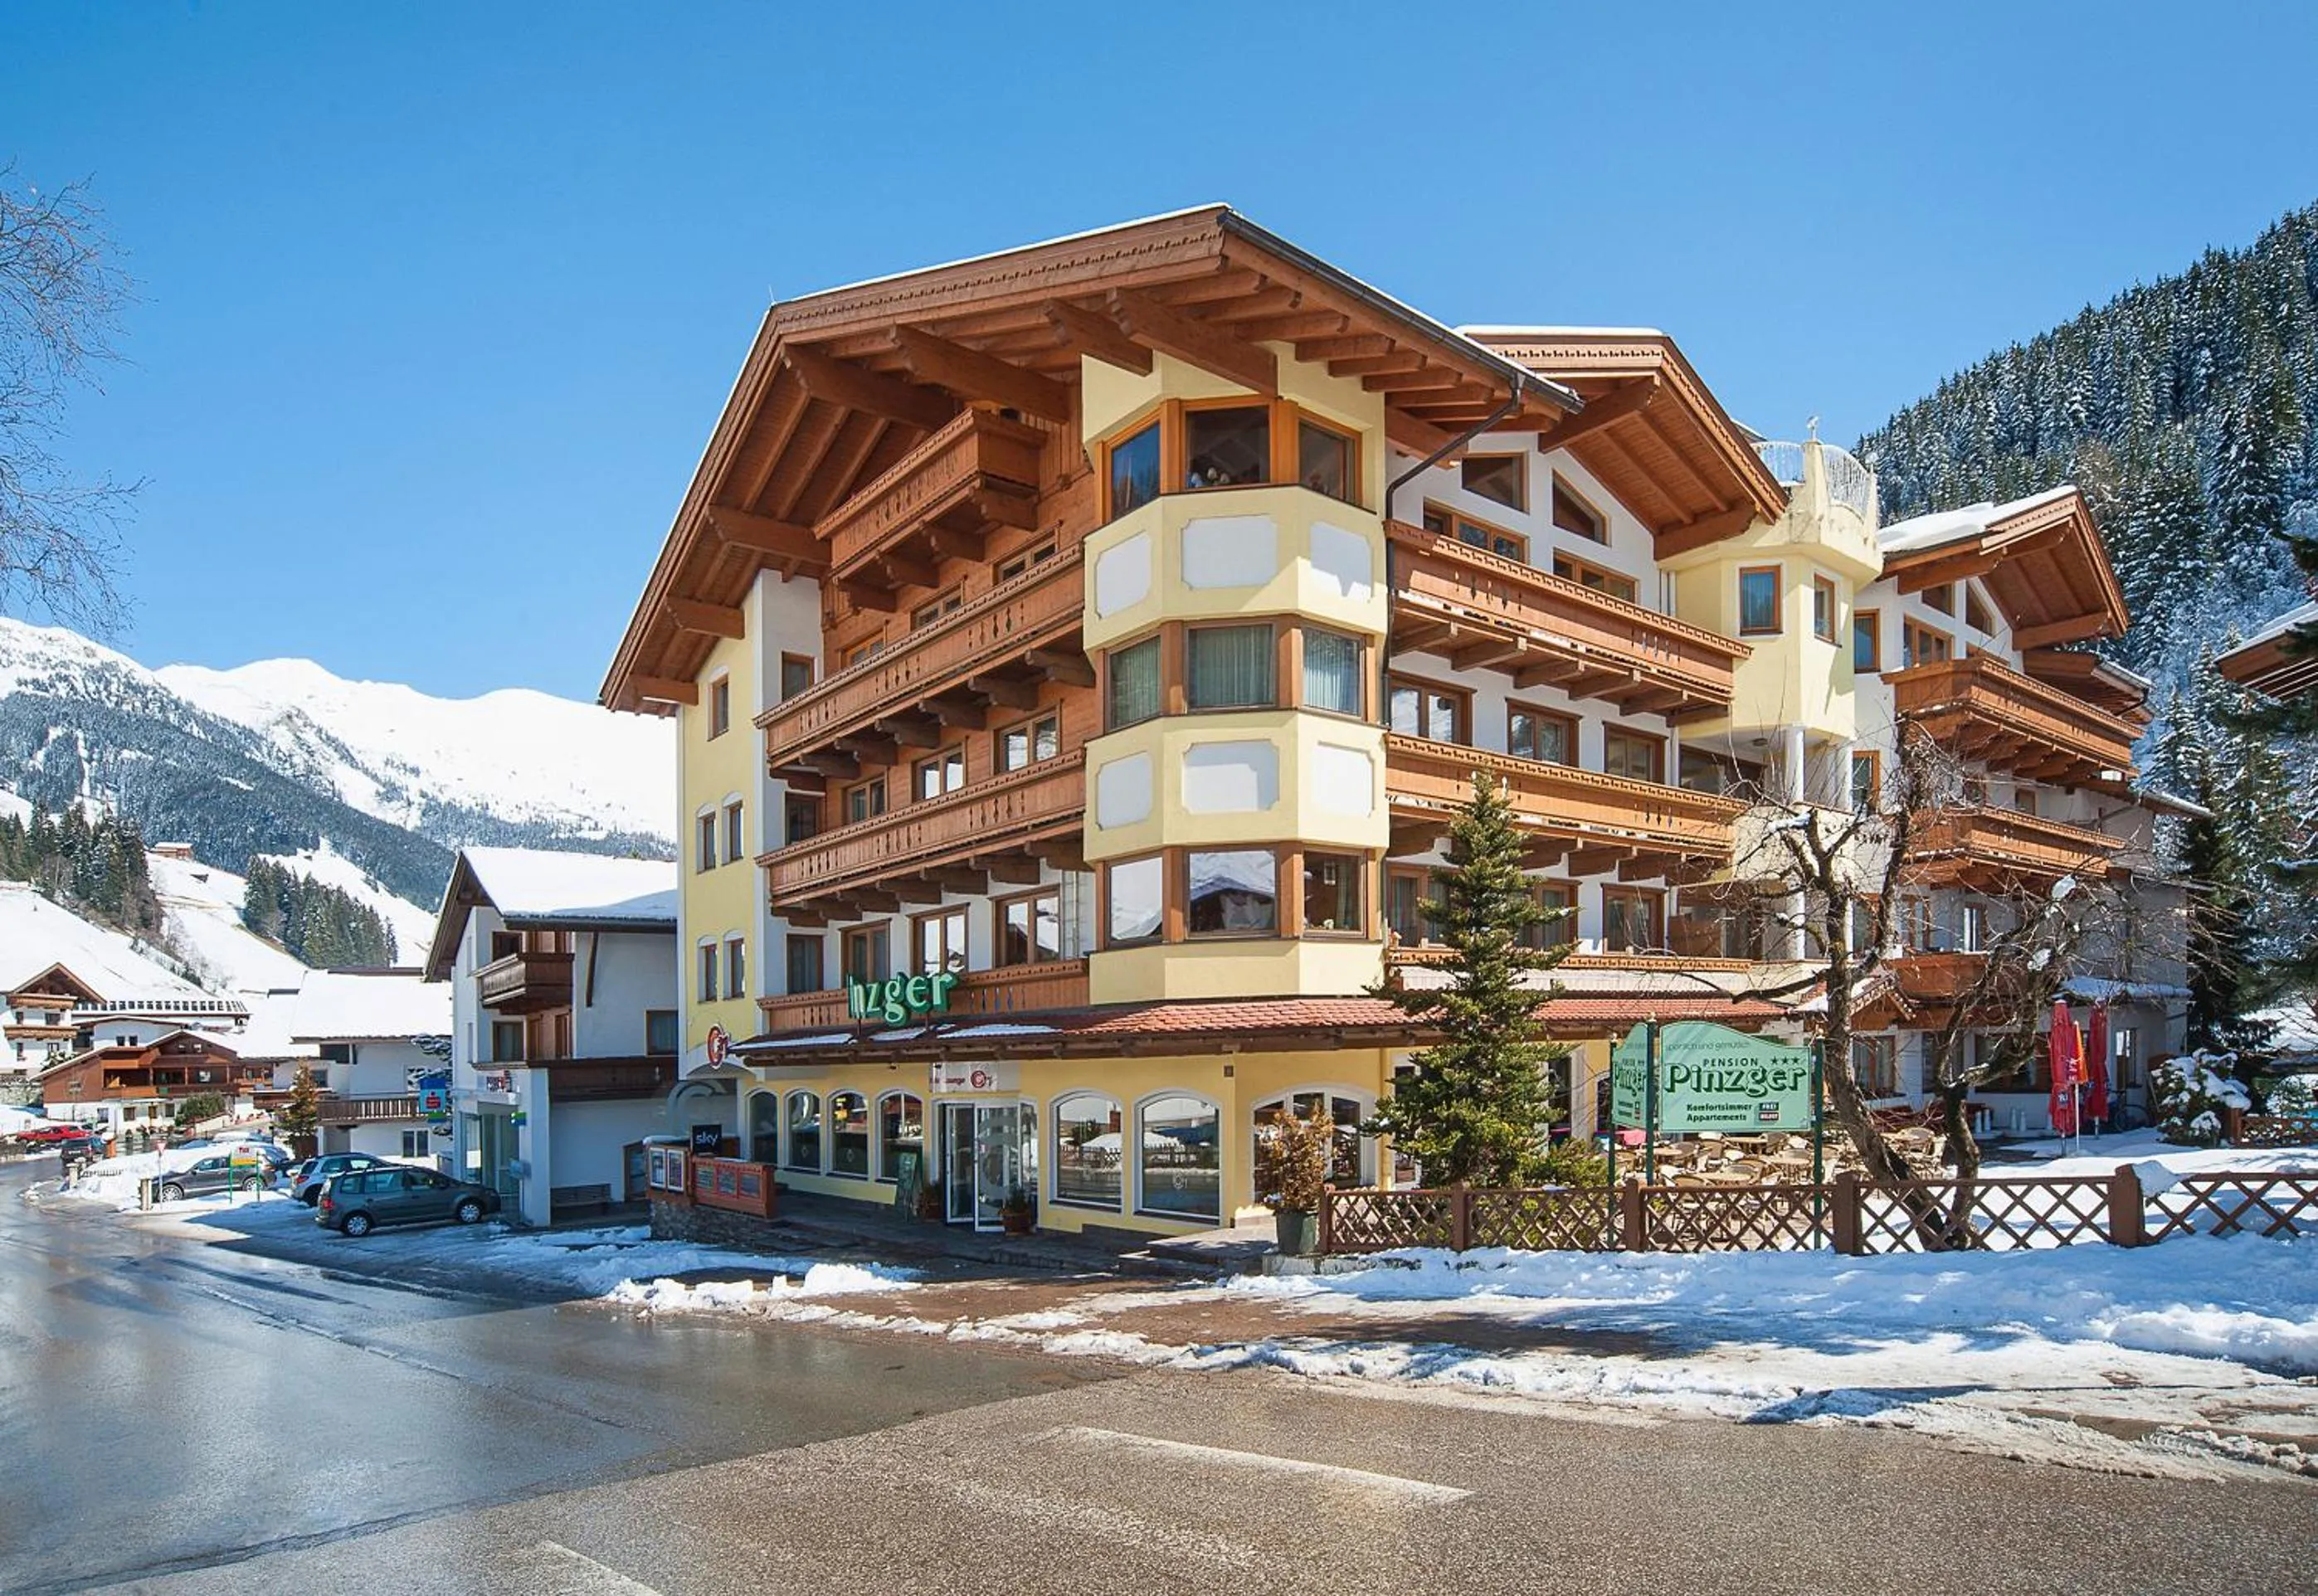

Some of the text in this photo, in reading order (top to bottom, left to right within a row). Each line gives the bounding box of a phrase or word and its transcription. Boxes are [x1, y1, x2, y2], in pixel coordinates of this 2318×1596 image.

[1702, 1058, 1758, 1067] PENSION
[1663, 1063, 1807, 1098] Pinzger
[696, 1131, 718, 1148] sky
